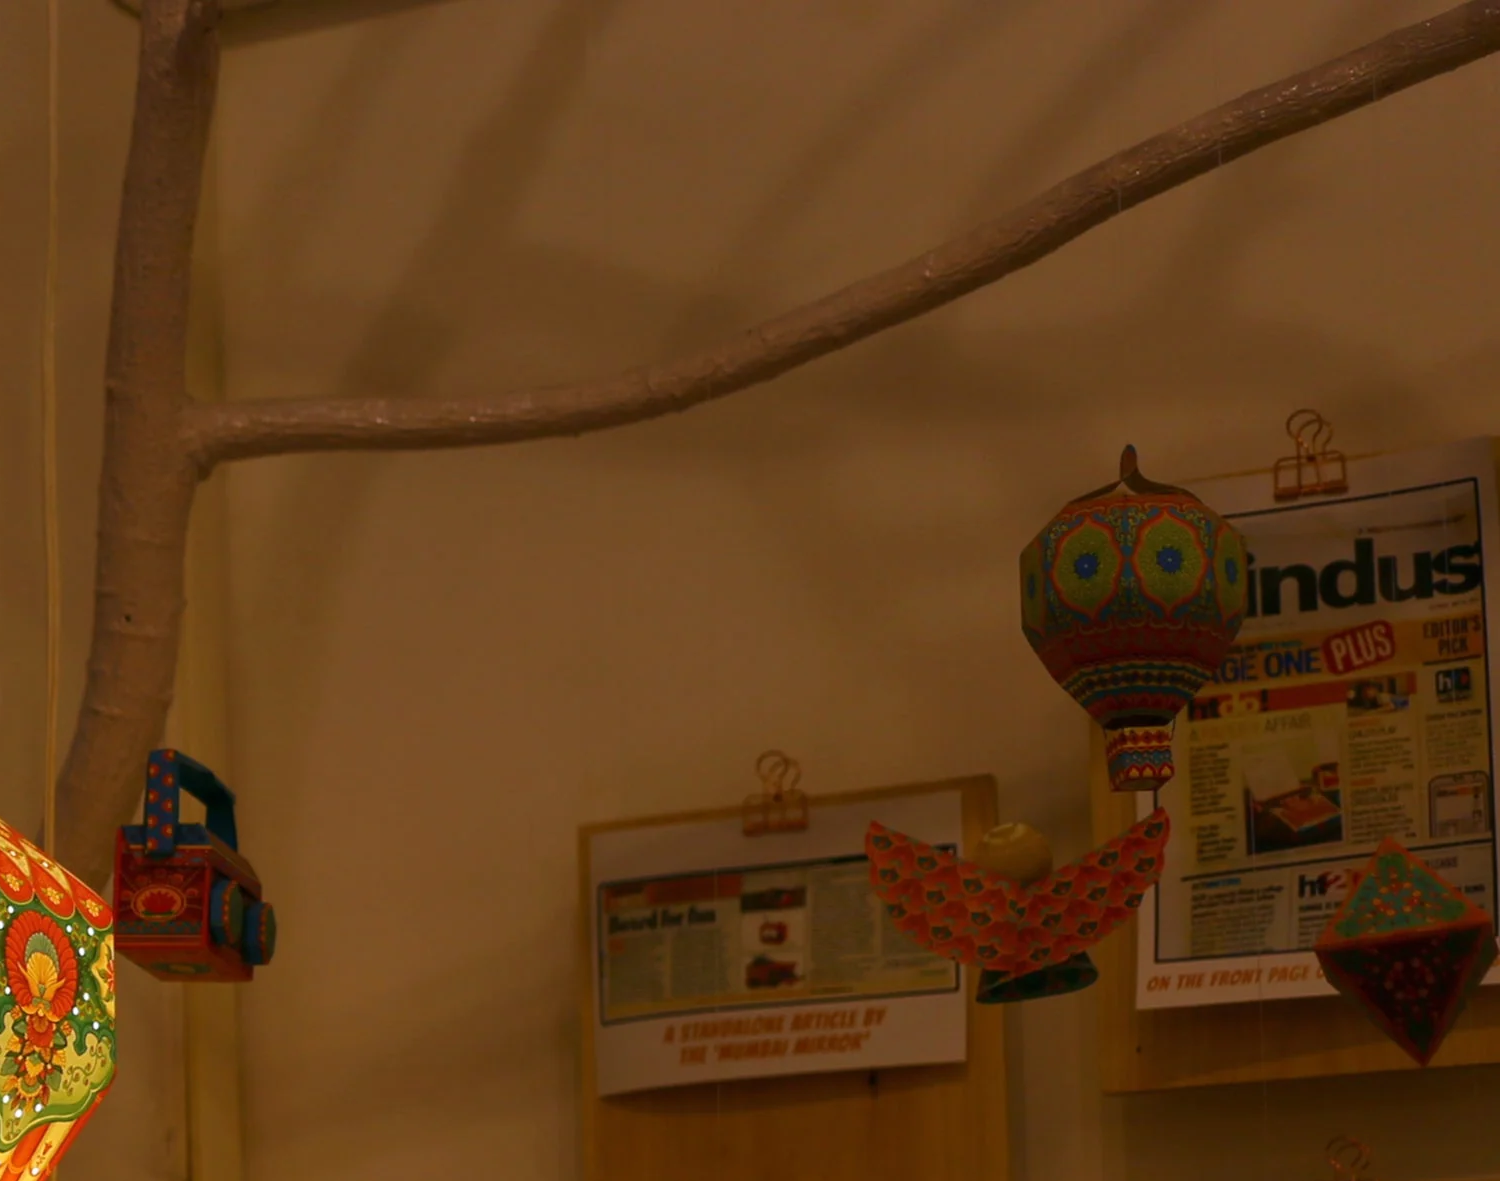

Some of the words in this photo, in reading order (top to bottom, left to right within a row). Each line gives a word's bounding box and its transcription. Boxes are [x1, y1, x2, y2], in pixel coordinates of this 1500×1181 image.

[1264, 646, 1322, 678] ONE
[1329, 623, 1393, 672] PLUS
[1146, 975, 1171, 993] ON
[1176, 971, 1206, 991] THE
[1209, 968, 1263, 988] FRONT
[1267, 964, 1312, 984] PAGE
[862, 1005, 889, 1027] BY
